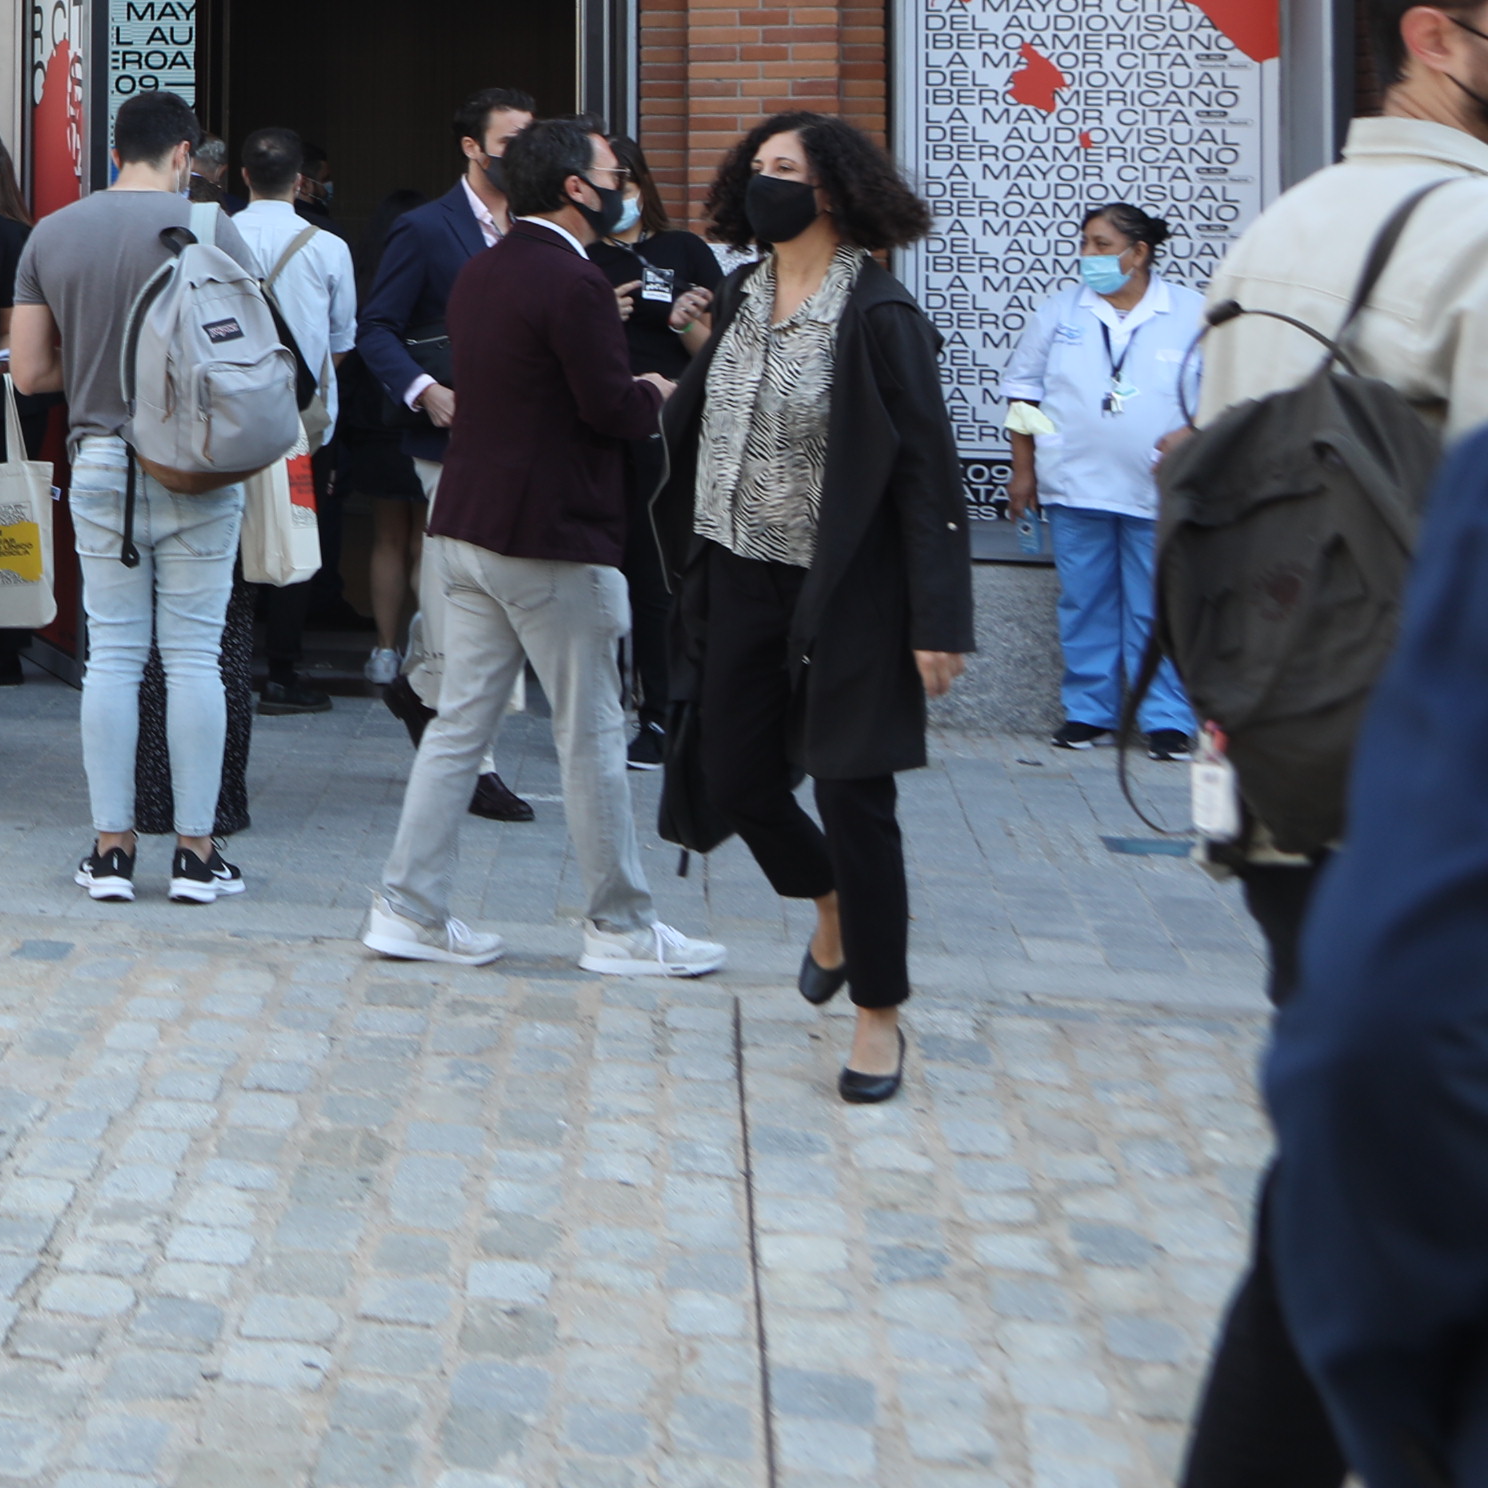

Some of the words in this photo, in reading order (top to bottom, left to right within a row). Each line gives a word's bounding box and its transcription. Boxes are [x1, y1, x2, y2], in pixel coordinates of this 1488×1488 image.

[924, 14, 990, 31] DEL
[924, 51, 968, 69] LA
[1116, 52, 1192, 70] CITA
[924, 70, 990, 88] DEL
[924, 107, 968, 125] LA
[981, 108, 1103, 126] MAYOR
[1116, 109, 1192, 127] CITA
[924, 126, 990, 144] DEL
[924, 145, 1239, 165] IBEROAMERICANO
[924, 163, 968, 181] LA
[981, 164, 1103, 183] MAYOR
[1116, 165, 1192, 184] CITA
[924, 182, 990, 200] DEL
[1002, 183, 1240, 203] AUDIOVISUAL
[924, 238, 990, 256] DEL
[924, 275, 968, 293] LA
[924, 294, 990, 312] DEL
